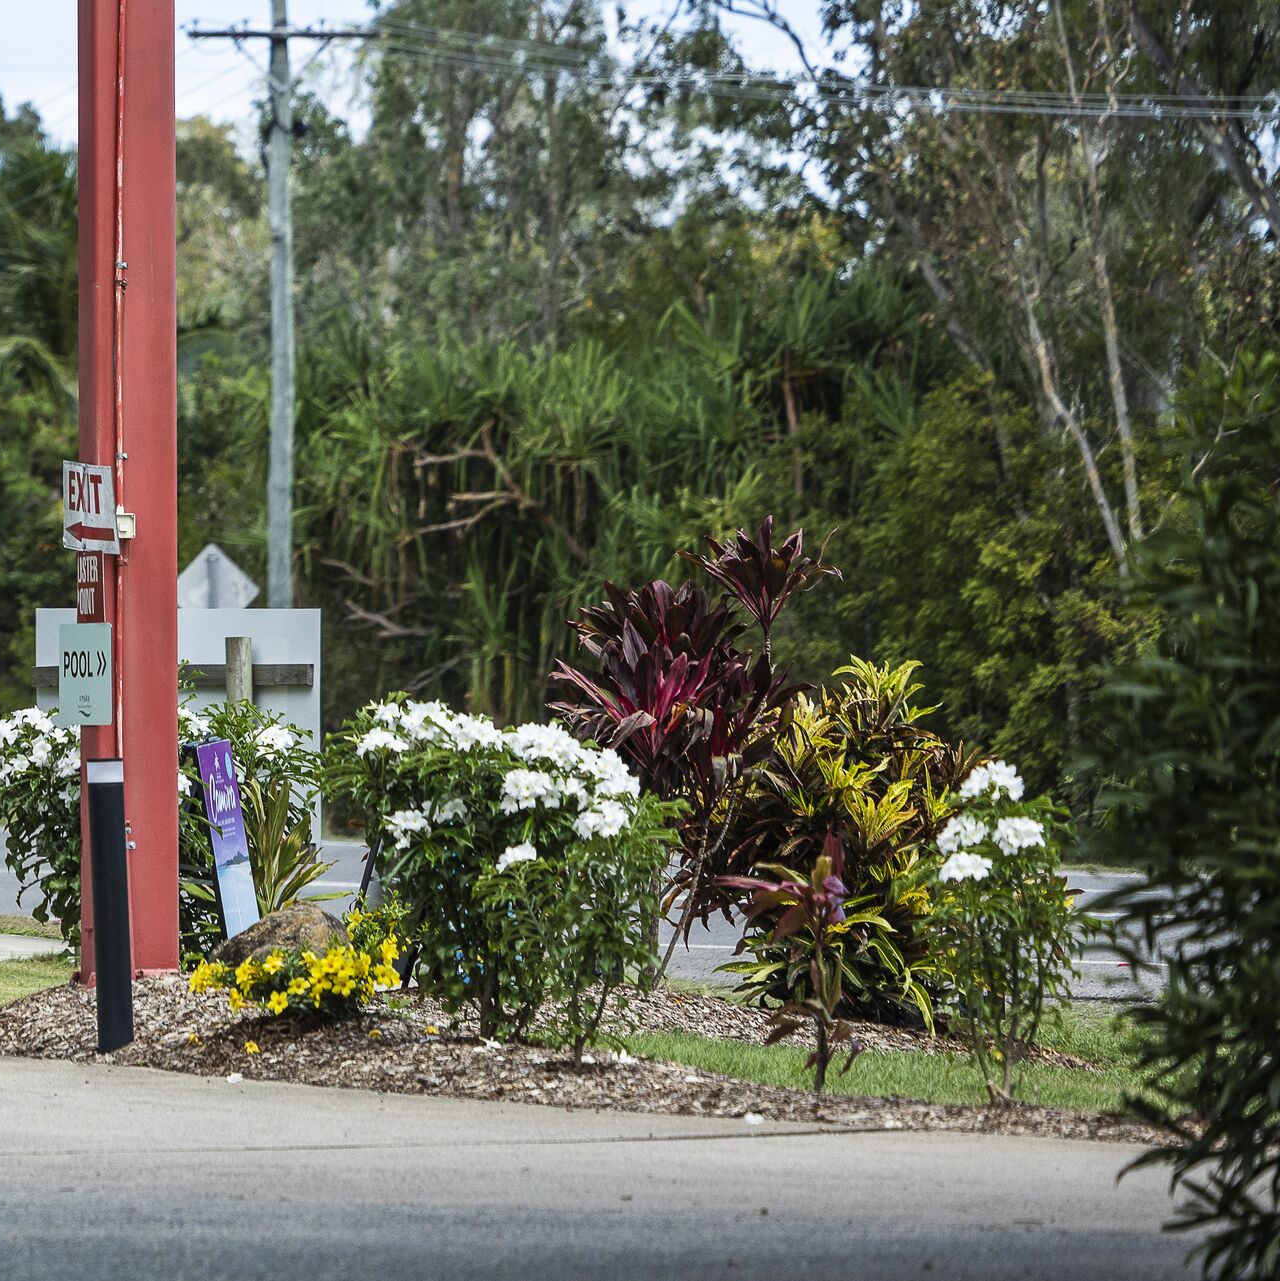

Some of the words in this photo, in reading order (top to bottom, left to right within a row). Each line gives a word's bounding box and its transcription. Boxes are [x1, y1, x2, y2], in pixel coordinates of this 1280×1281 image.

[68, 470, 103, 515] EXIT
[77, 555, 98, 583] USTER
[77, 587, 95, 615] OINT
[63, 650, 93, 678] POOL
